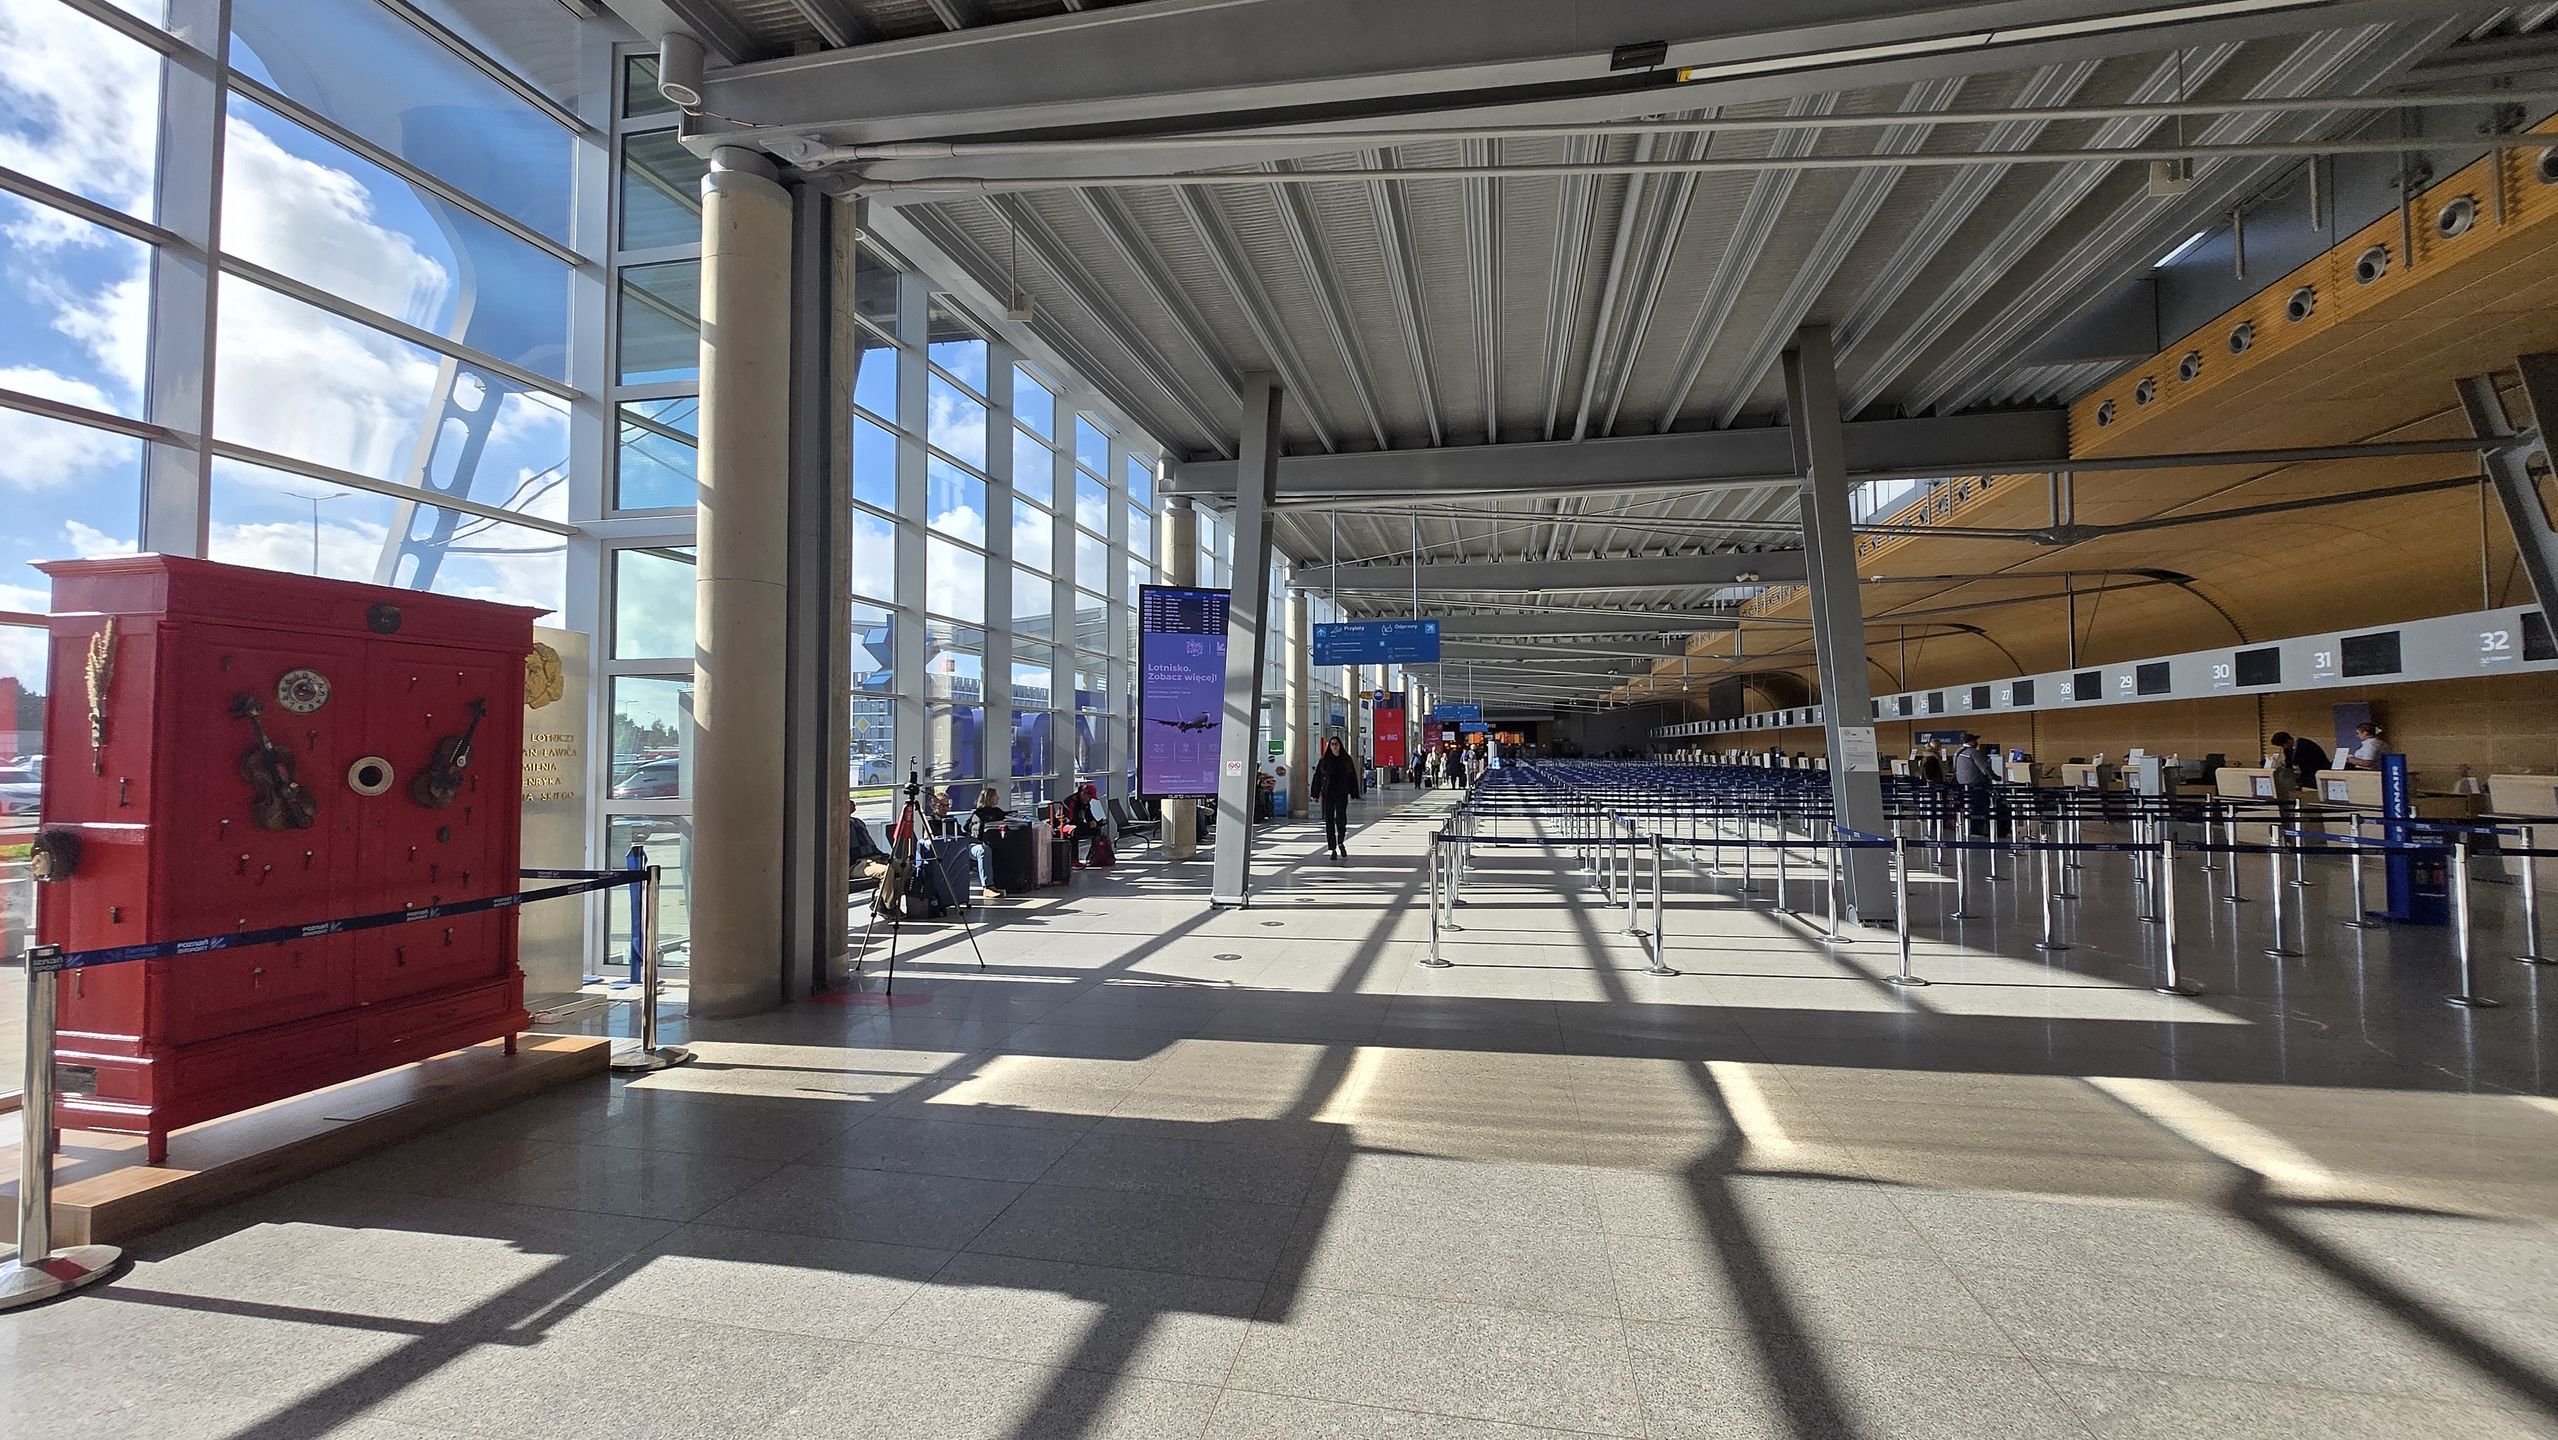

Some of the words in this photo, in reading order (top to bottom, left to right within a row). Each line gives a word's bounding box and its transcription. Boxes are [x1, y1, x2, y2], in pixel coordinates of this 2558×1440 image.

[2480, 630, 2510, 652] 32
[2314, 652, 2331, 669] 31
[1148, 663, 1192, 672] Lotnisko.
[2212, 664, 2230, 679] 30
[1148, 672, 1182, 680] Zobacz
[1184, 673, 1217, 683] więcej!
[2119, 675, 2133, 689] 29
[2001, 689, 2011, 700] 27
[2060, 683, 2072, 695] 28
[531, 733, 576, 742] LOTNICZY
[523, 763, 557, 771] MIENIA
